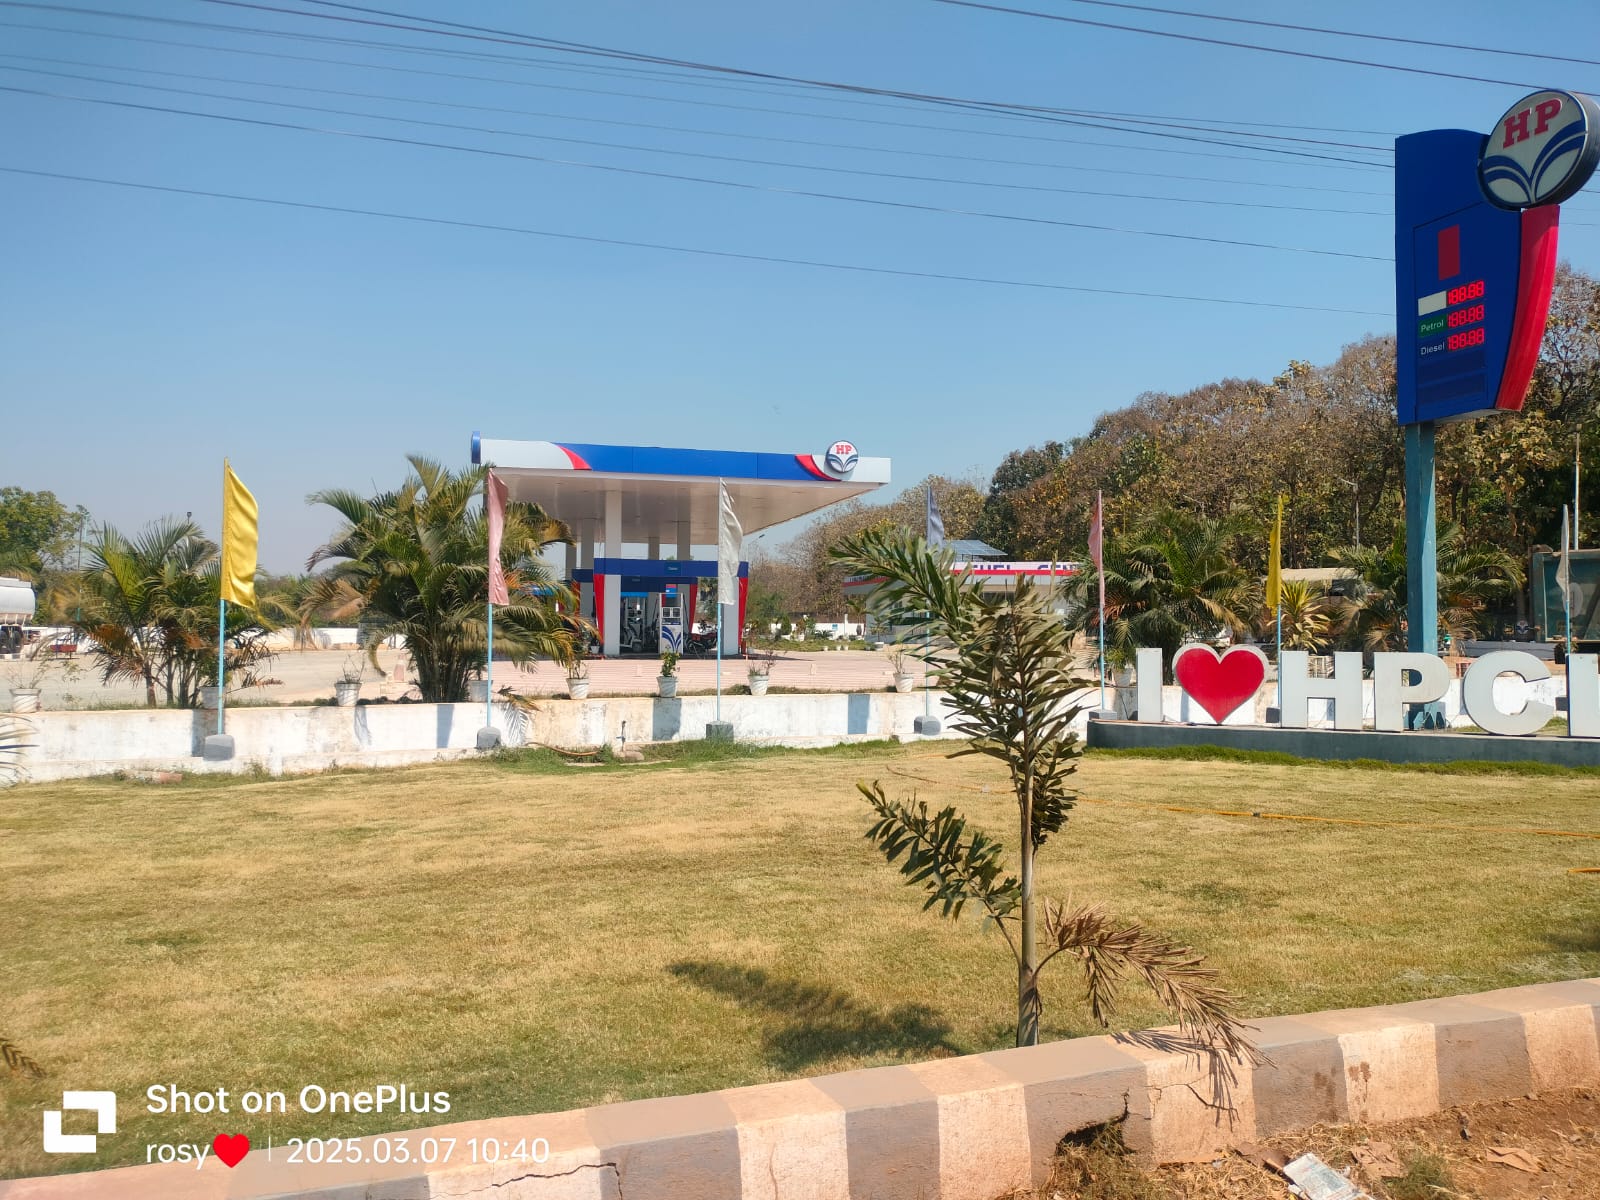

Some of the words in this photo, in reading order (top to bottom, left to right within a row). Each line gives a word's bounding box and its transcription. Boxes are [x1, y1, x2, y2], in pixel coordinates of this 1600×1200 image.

[1503, 98, 1562, 149] HP
[1421, 320, 1444, 333] Petrol
[1421, 341, 1445, 355] Diesel
[835, 444, 853, 455] HP
[1136, 648, 1163, 722] I
